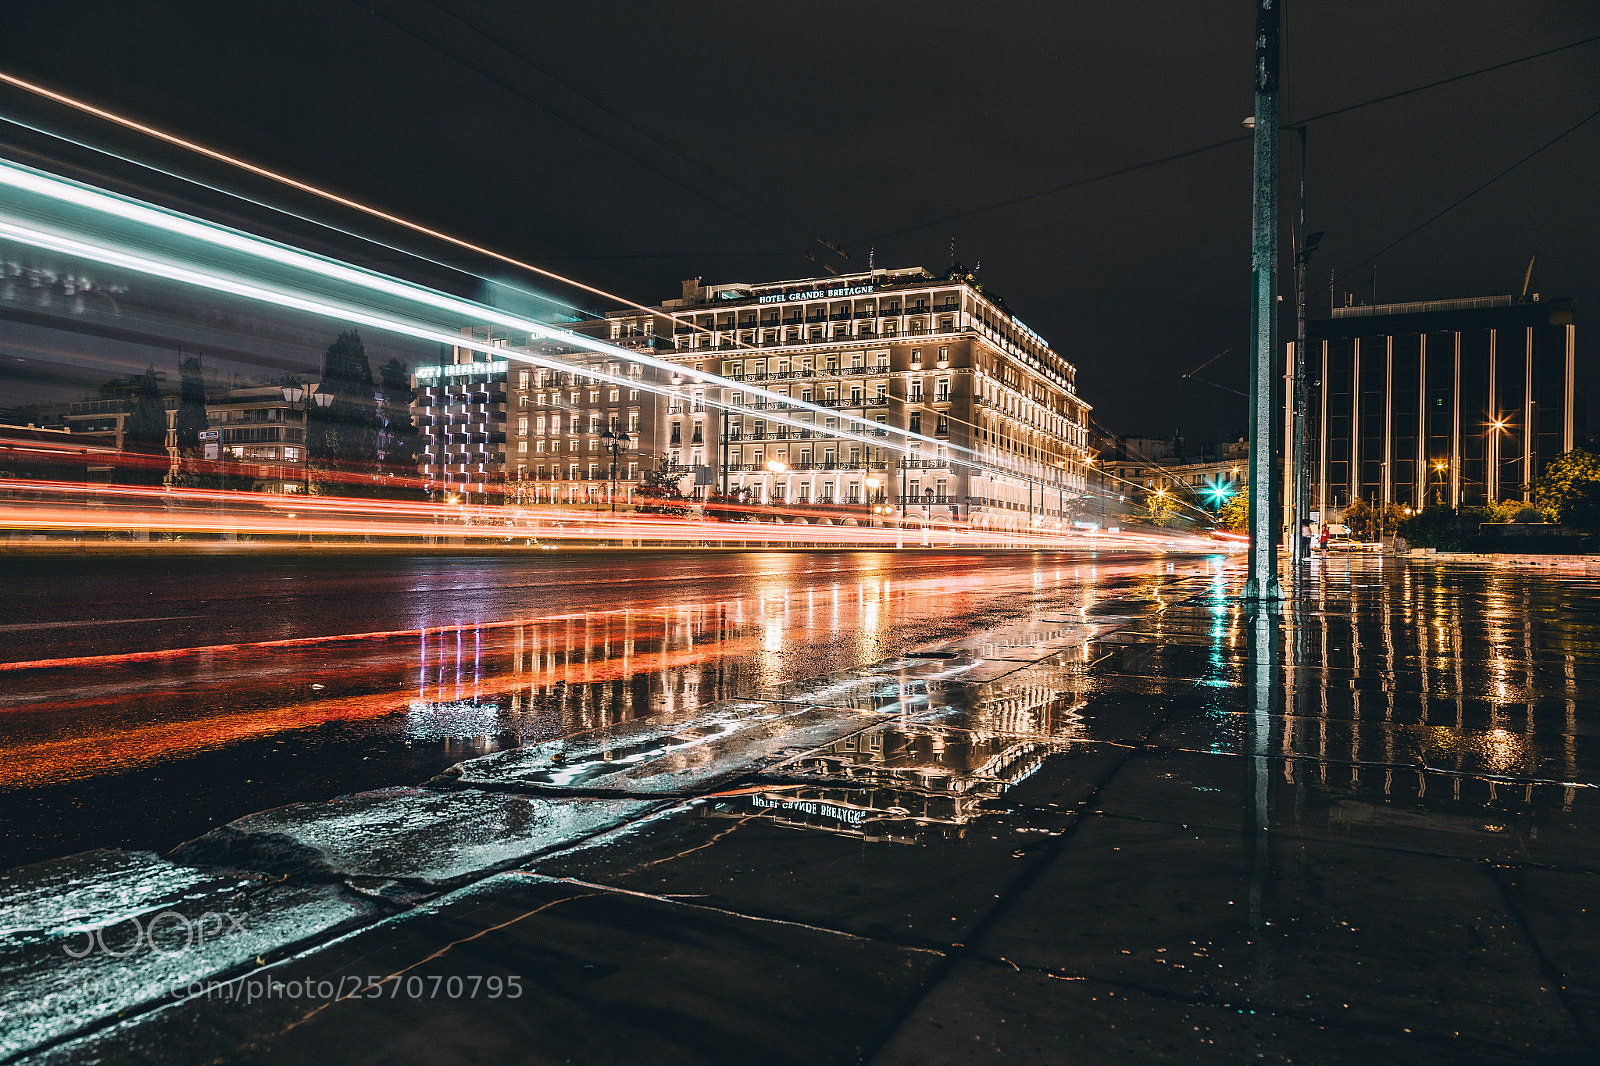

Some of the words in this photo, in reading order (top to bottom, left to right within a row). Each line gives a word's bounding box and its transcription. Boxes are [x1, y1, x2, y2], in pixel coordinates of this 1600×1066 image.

[760, 294, 786, 304] HOTEL
[789, 290, 824, 301] GRANDE
[828, 285, 874, 298] BRETAGNE
